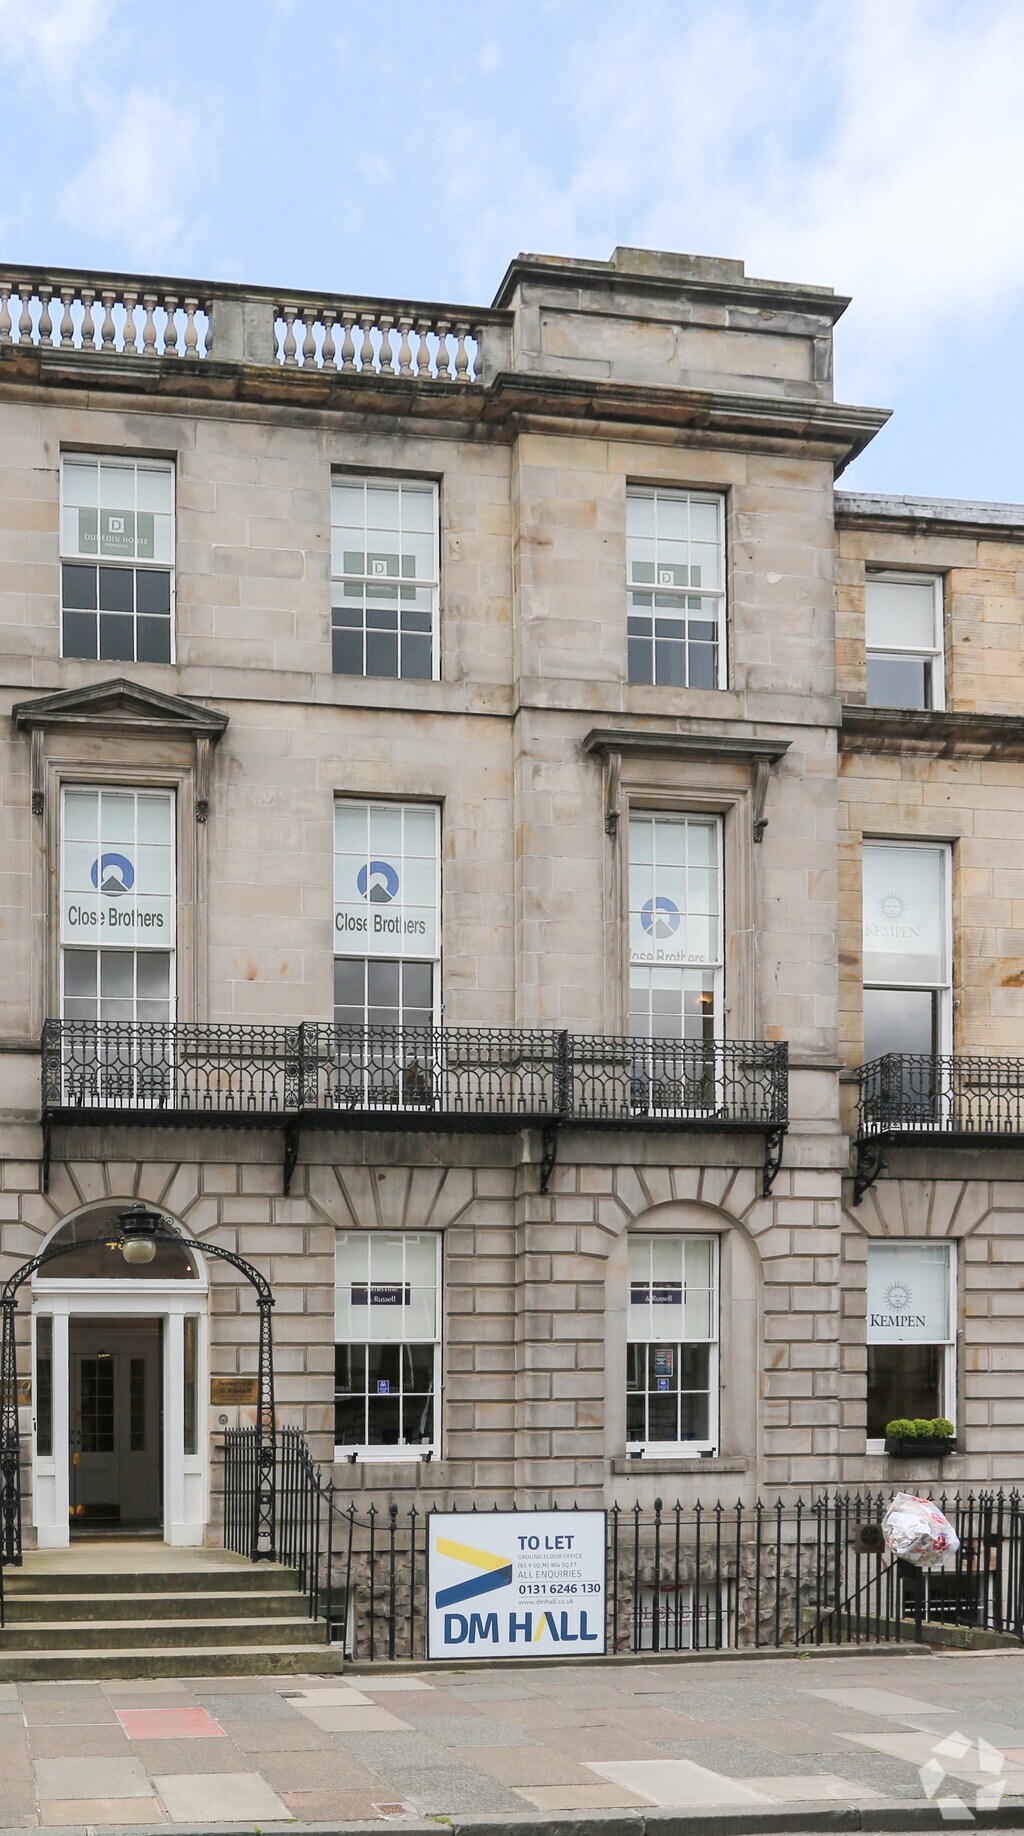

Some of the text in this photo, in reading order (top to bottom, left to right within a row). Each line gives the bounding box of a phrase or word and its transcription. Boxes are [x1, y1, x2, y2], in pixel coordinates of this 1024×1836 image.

[108, 907, 164, 928] Brothers
[335, 912, 368, 932] Close
[865, 923, 921, 939] KEMPEN
[373, 1295, 396, 1303] Russell
[869, 1313, 926, 1327] KEMPEN
[517, 1535, 575, 1550] TO LET
[517, 1569, 582, 1579] ALL ENQUIRIES
[518, 1583, 601, 1594] 0131 6246 130
[444, 1610, 598, 1644] DM HALL
